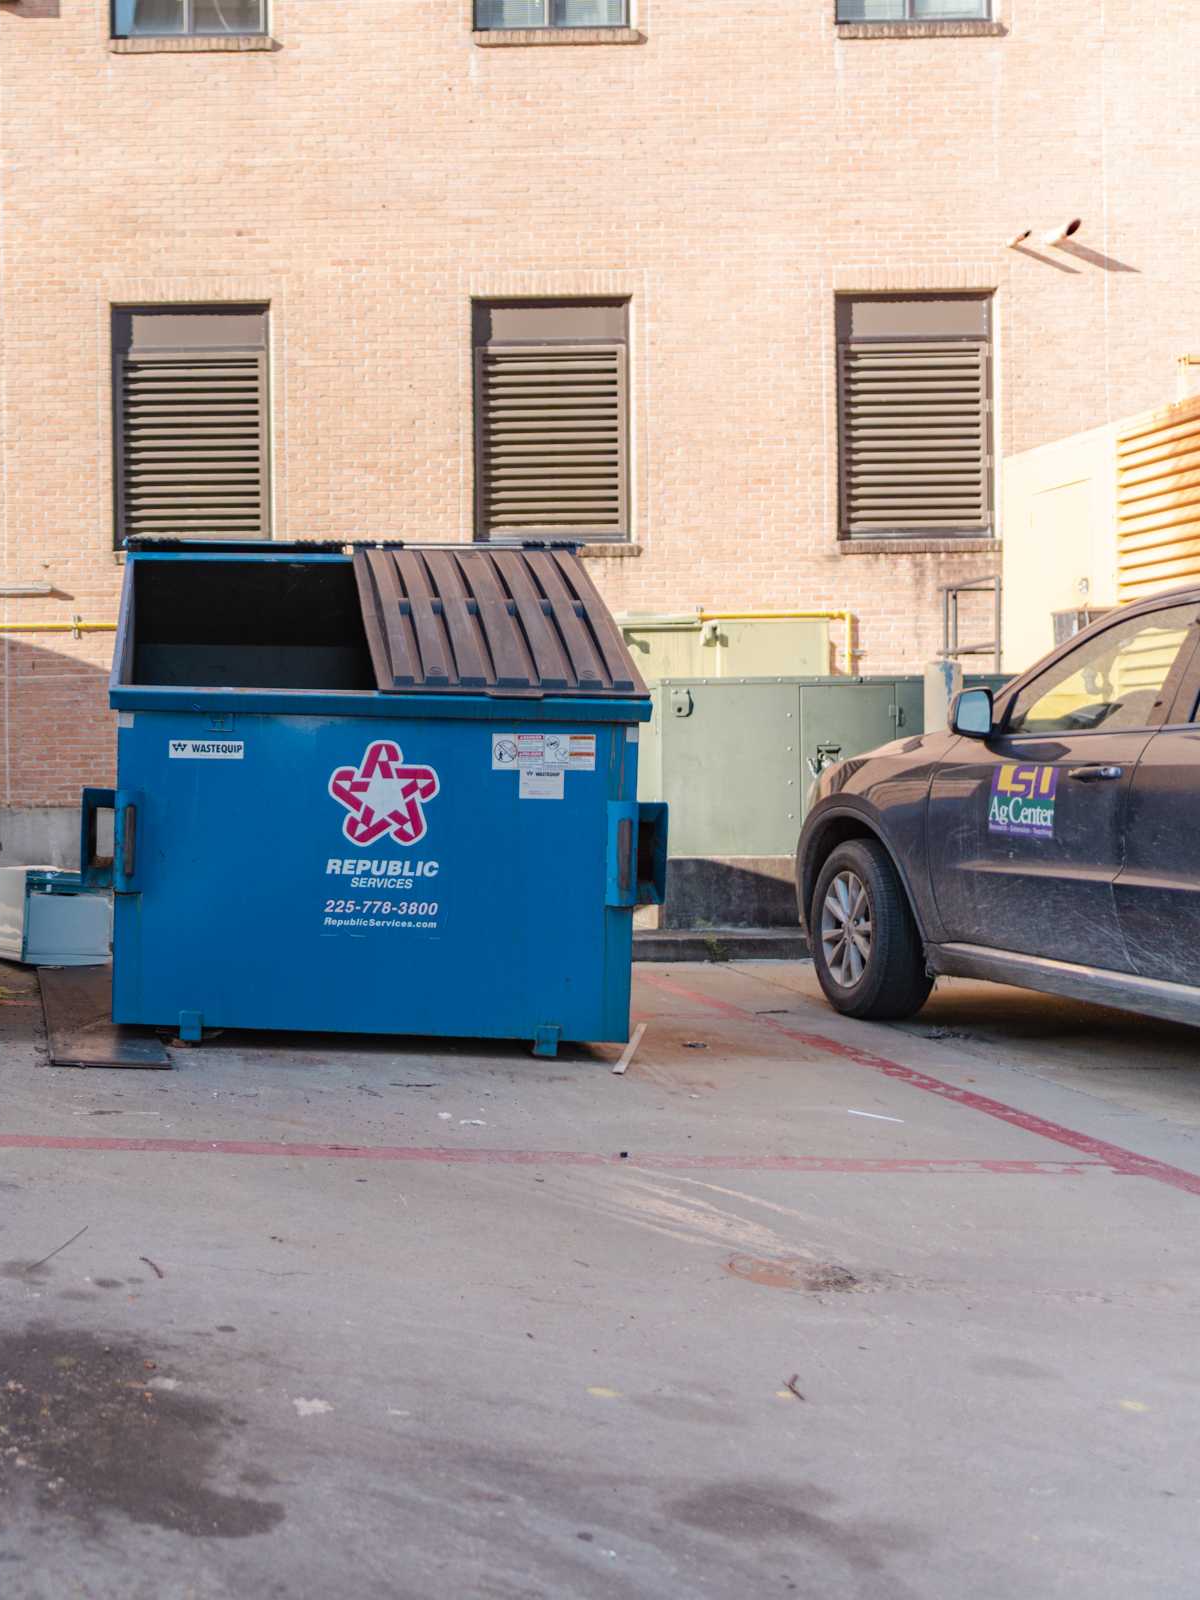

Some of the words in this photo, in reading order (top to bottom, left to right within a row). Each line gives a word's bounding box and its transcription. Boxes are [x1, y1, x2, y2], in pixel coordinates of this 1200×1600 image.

[192, 743, 242, 753] WASTEQUIP
[993, 765, 1058, 800] LSU
[326, 859, 439, 877] REPUBLIC
[350, 877, 413, 889] SERVICES
[324, 900, 438, 915] 225-778-3800
[324, 917, 437, 928] RepublicServices.com
